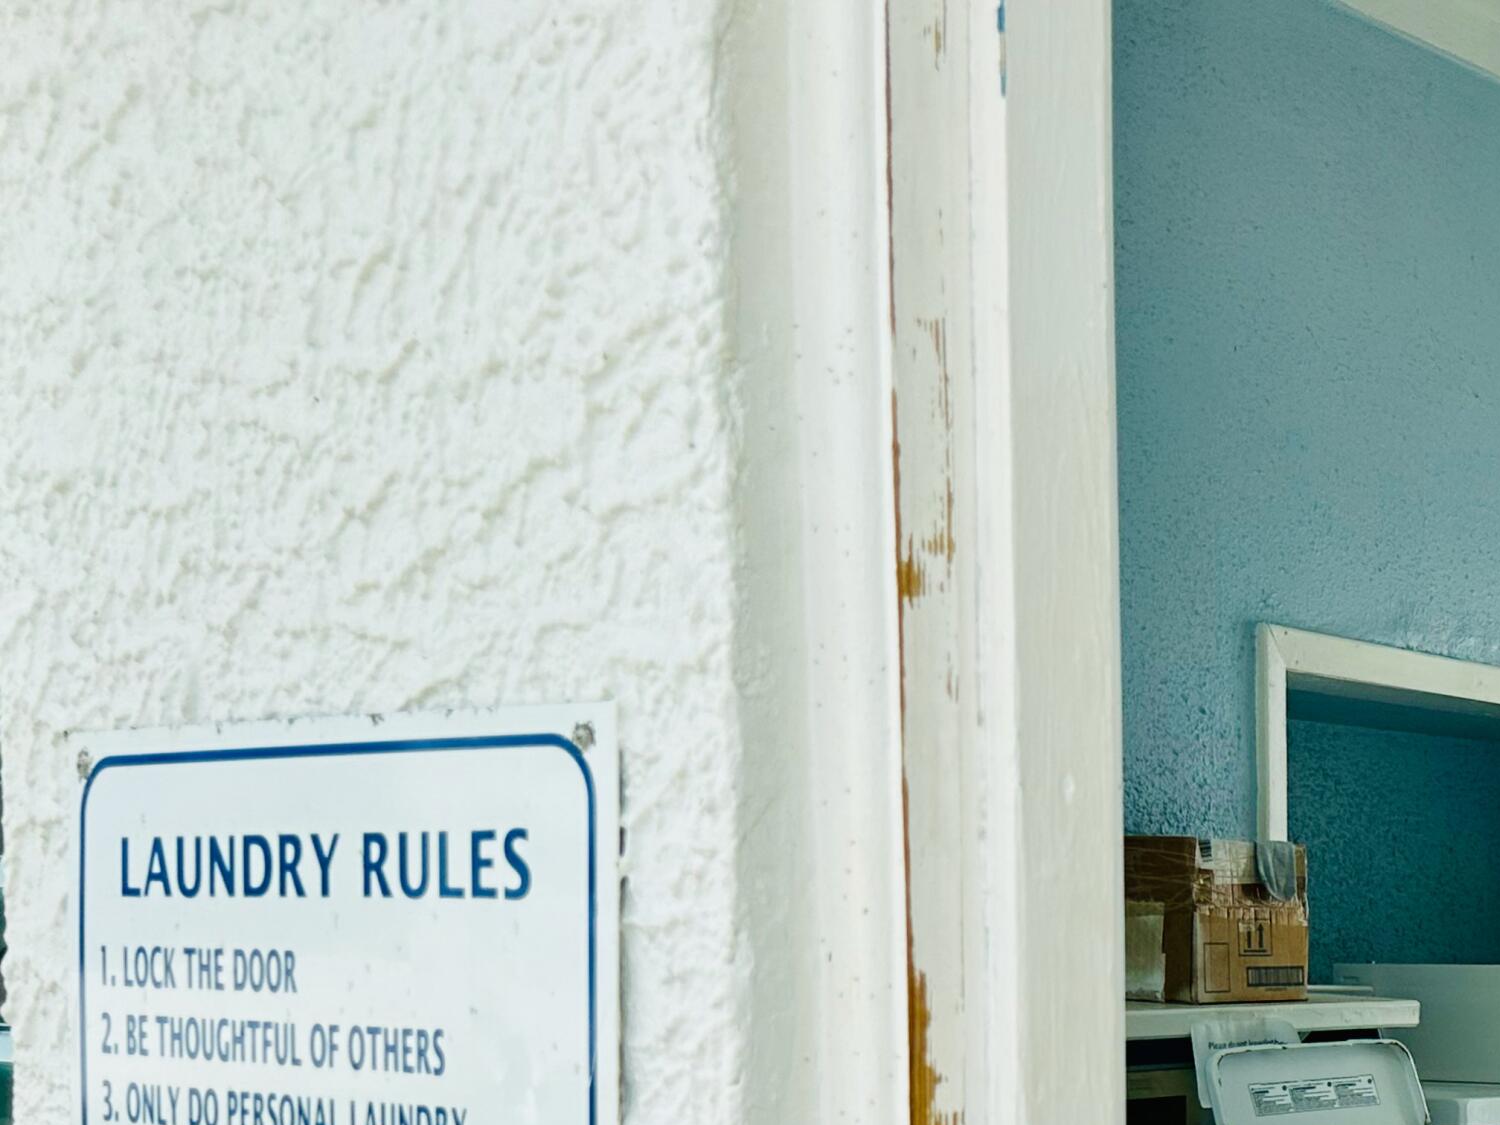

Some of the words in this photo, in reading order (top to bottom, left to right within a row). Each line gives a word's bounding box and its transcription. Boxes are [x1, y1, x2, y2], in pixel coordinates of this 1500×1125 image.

[120, 832, 341, 900] LAUNDRY
[359, 826, 533, 902] RULES
[100, 944, 116, 987] 1.
[122, 945, 177, 990] LOCK
[182, 946, 225, 991] THE
[232, 947, 298, 994] DOOR
[101, 1011, 119, 1055] 2.
[126, 1014, 149, 1057] BE
[154, 1015, 303, 1067] THOUGHTFUL
[309, 1023, 340, 1069] OF
[347, 1024, 446, 1077] OTHERS
[102, 1079, 120, 1122] 3.
